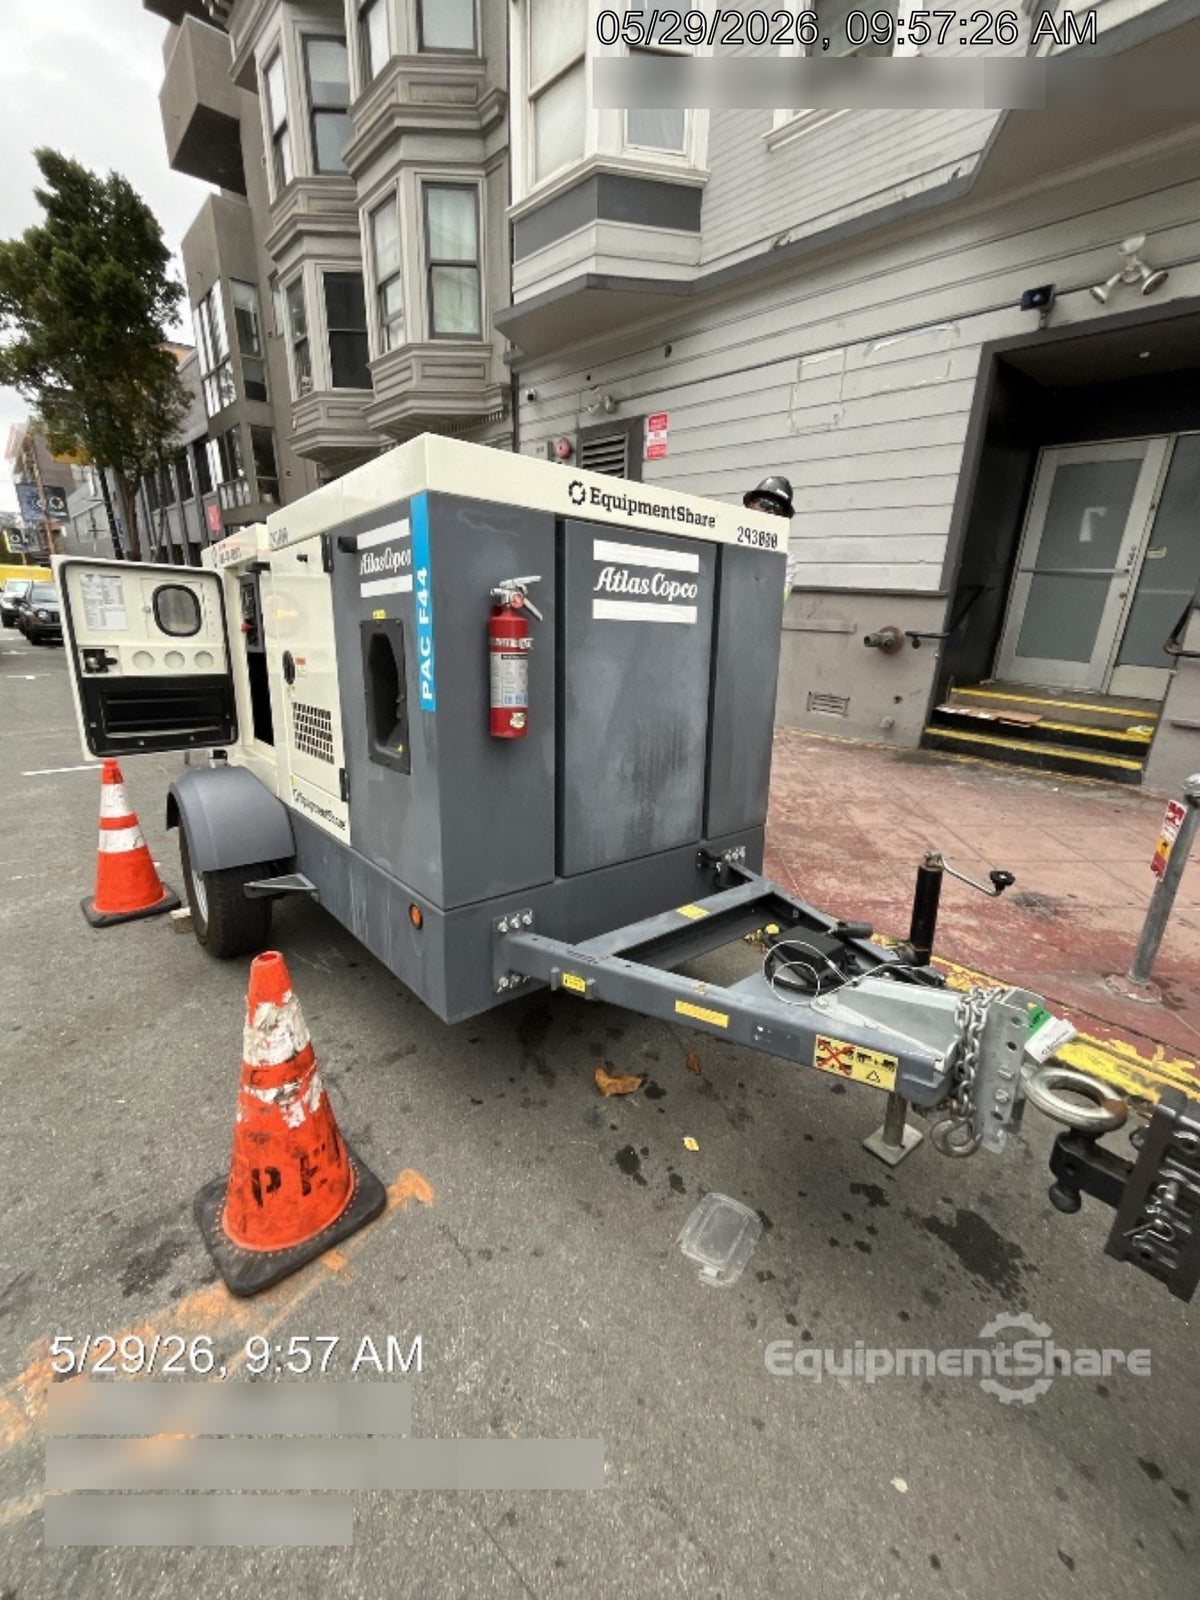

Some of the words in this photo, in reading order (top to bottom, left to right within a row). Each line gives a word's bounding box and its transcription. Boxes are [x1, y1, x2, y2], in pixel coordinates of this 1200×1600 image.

[590, 486, 716, 528] EquipmentShare
[359, 552, 385, 576] Atlas
[593, 566, 650, 595] Atlas
[651, 572, 698, 601] Copco
[417, 566, 430, 624] F44
[420, 636, 433, 700] PAC
